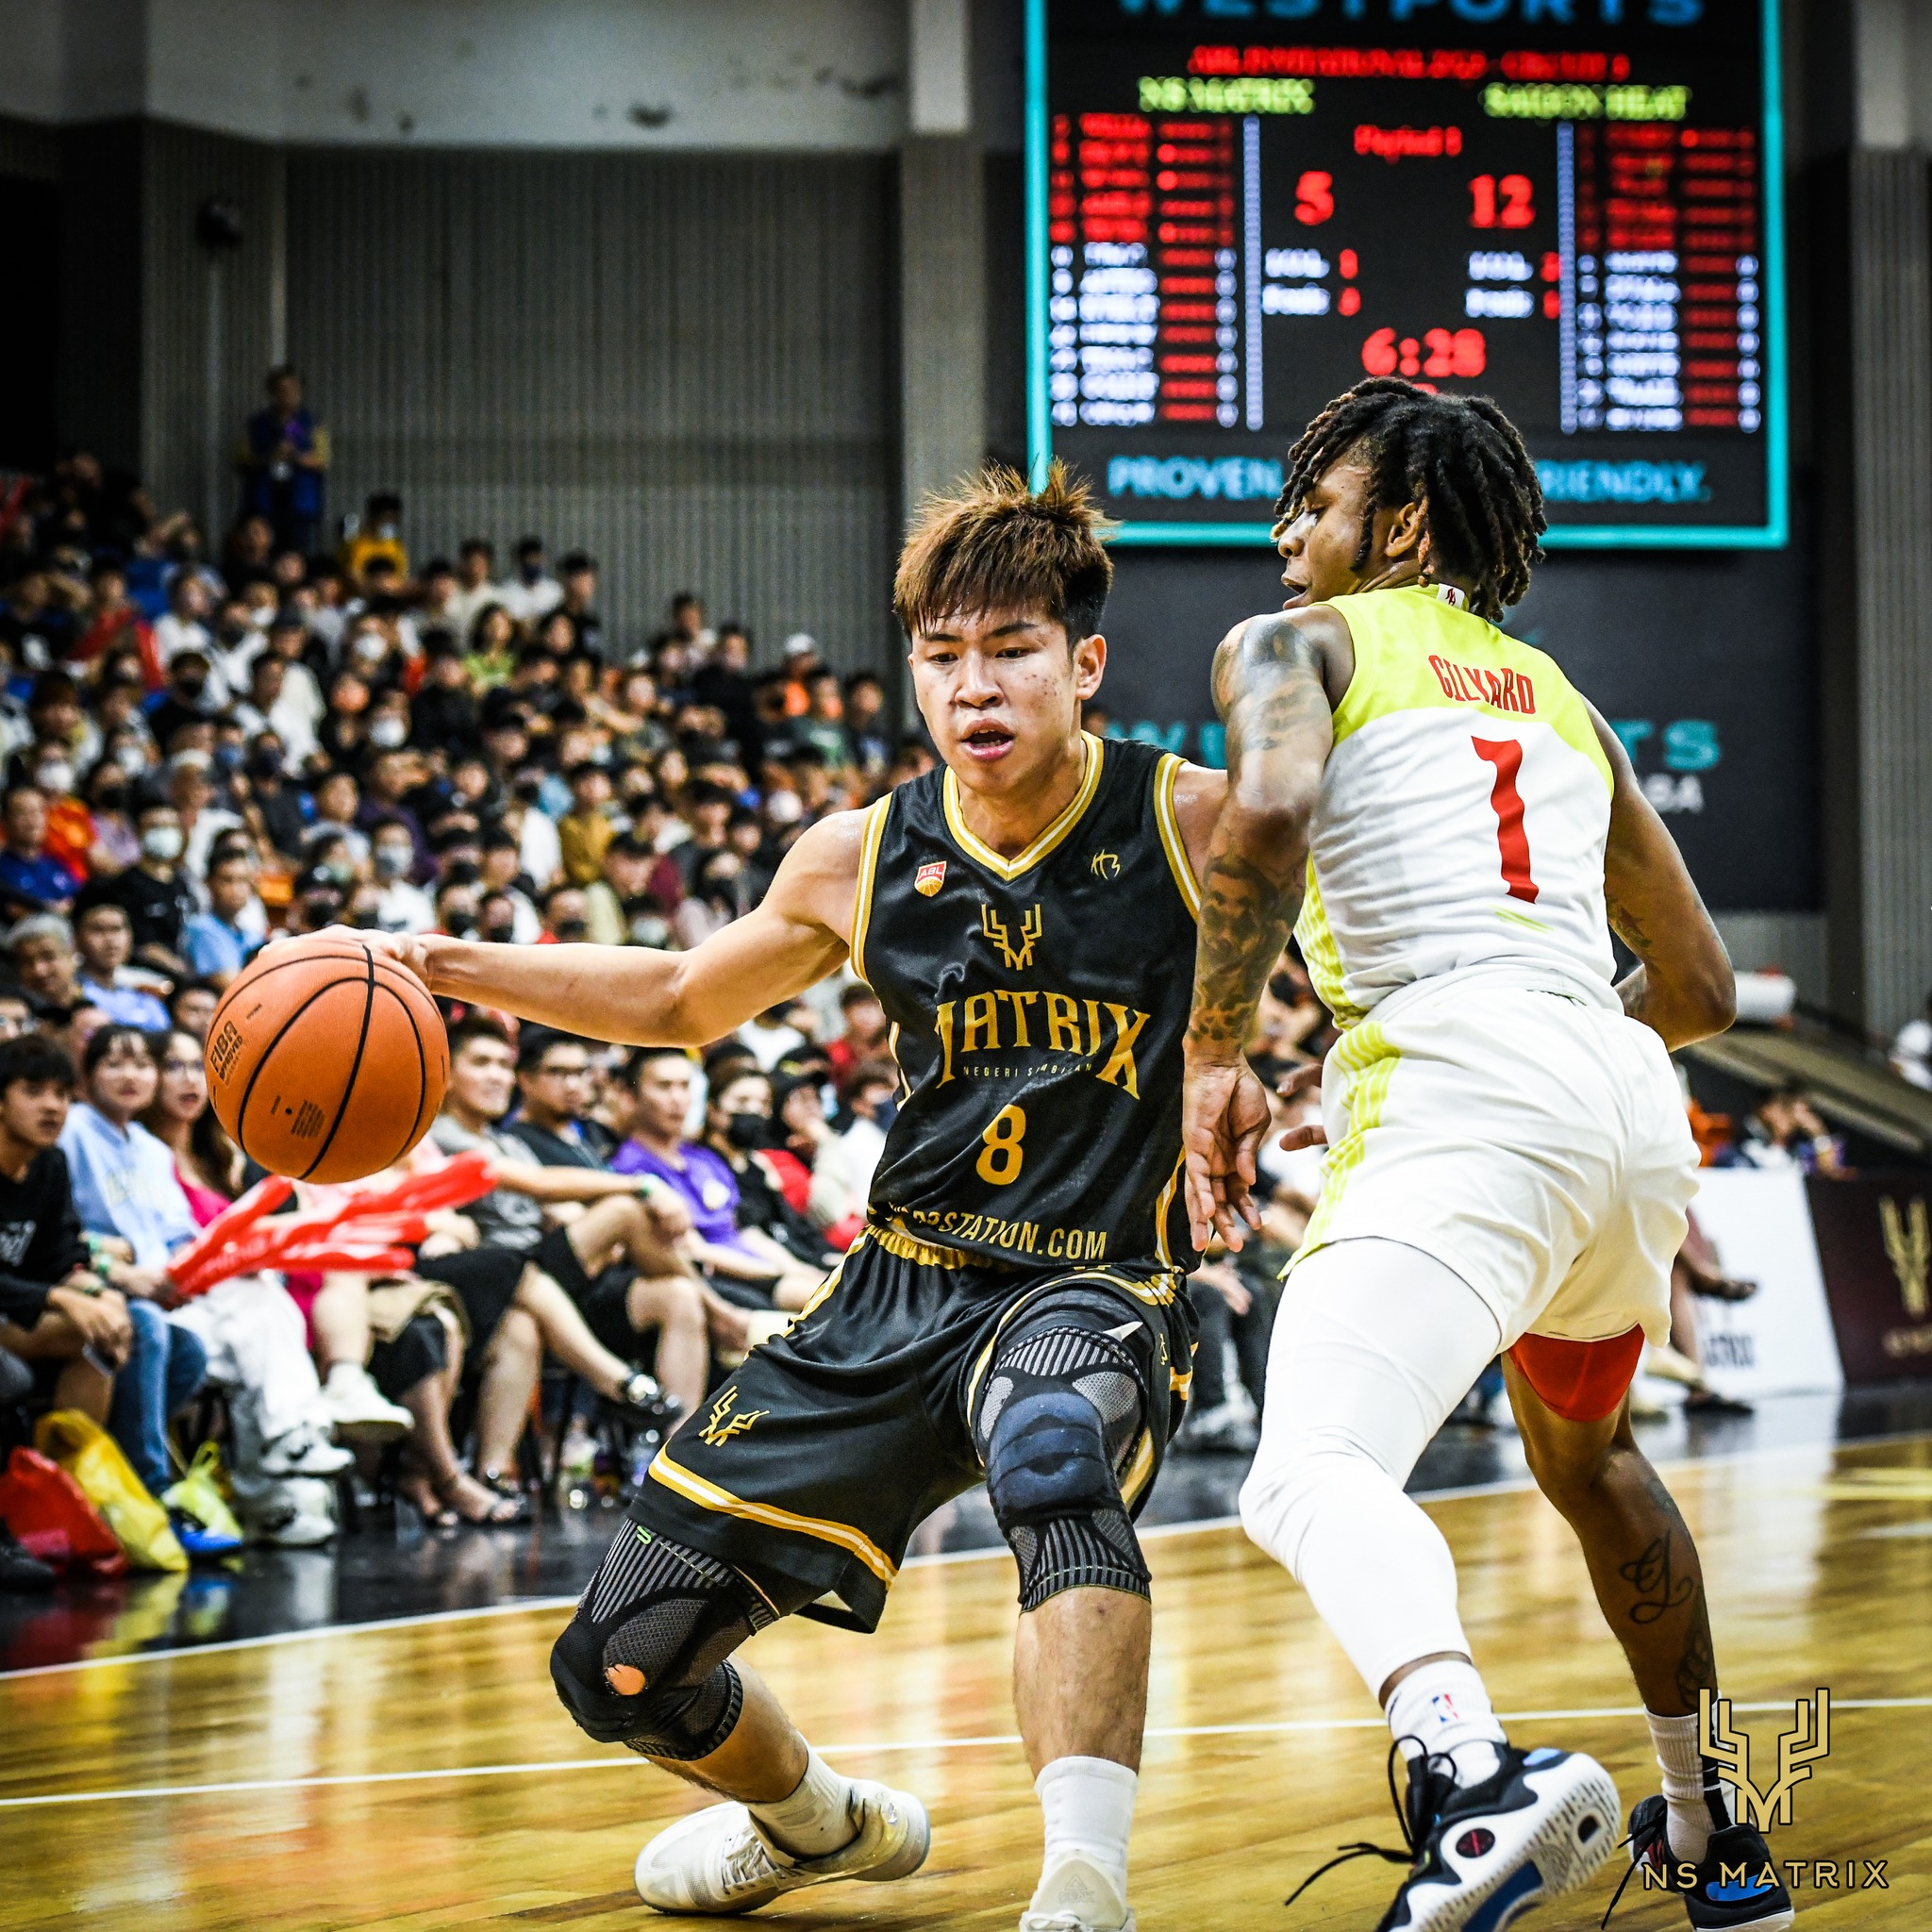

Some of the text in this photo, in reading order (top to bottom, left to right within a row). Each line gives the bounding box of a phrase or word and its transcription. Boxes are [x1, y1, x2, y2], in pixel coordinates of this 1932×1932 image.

[1294, 171, 1334, 225] 5
[1470, 174, 1535, 228] 12
[1428, 655, 1536, 714] GILYARD
[1471, 736, 1539, 904] 1
[919, 866, 942, 879] ABL
[210, 1020, 238, 1074] FIBA
[963, 1066, 1019, 1077] NEGERI
[975, 1104, 1026, 1185] 8
